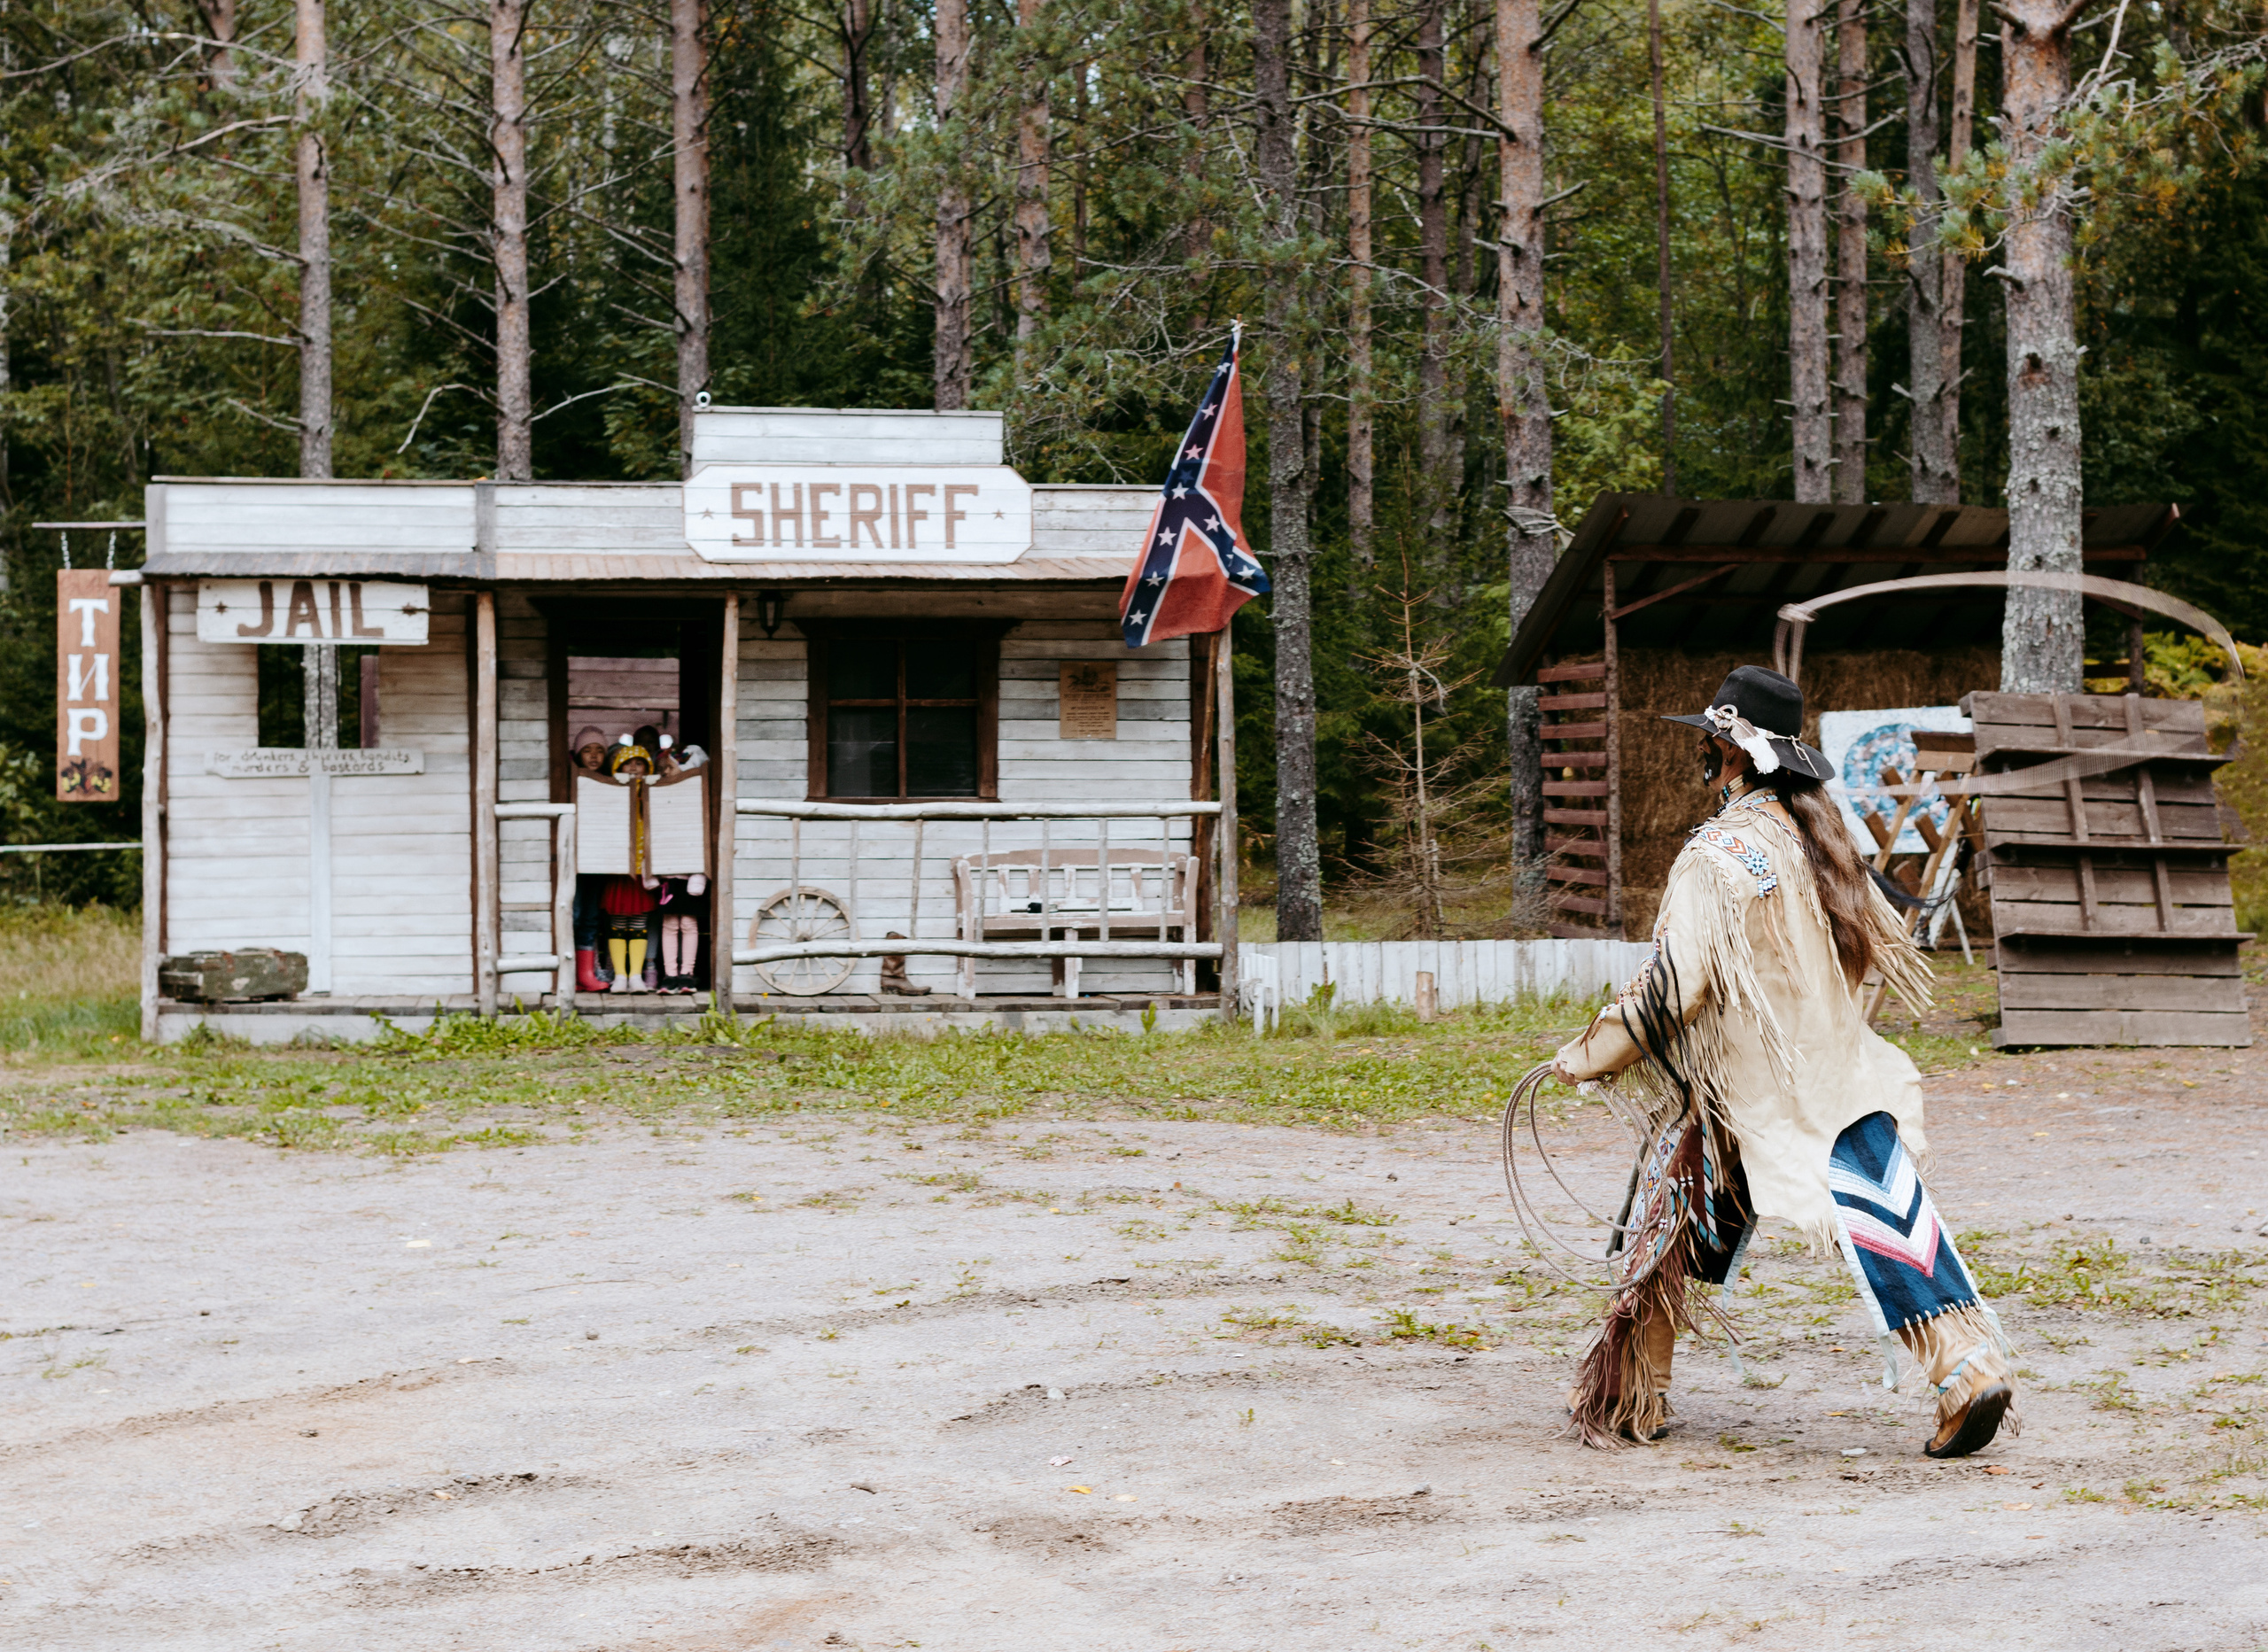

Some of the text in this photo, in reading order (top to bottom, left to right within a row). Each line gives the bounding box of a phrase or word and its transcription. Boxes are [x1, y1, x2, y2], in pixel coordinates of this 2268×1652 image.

[730, 482, 979, 549] SHERIFF
[237, 580, 384, 638] JAIL
[67, 597, 110, 756] ТИР
[214, 751, 231, 764] for
[298, 760, 310, 773] &
[321, 758, 384, 772] bastards
